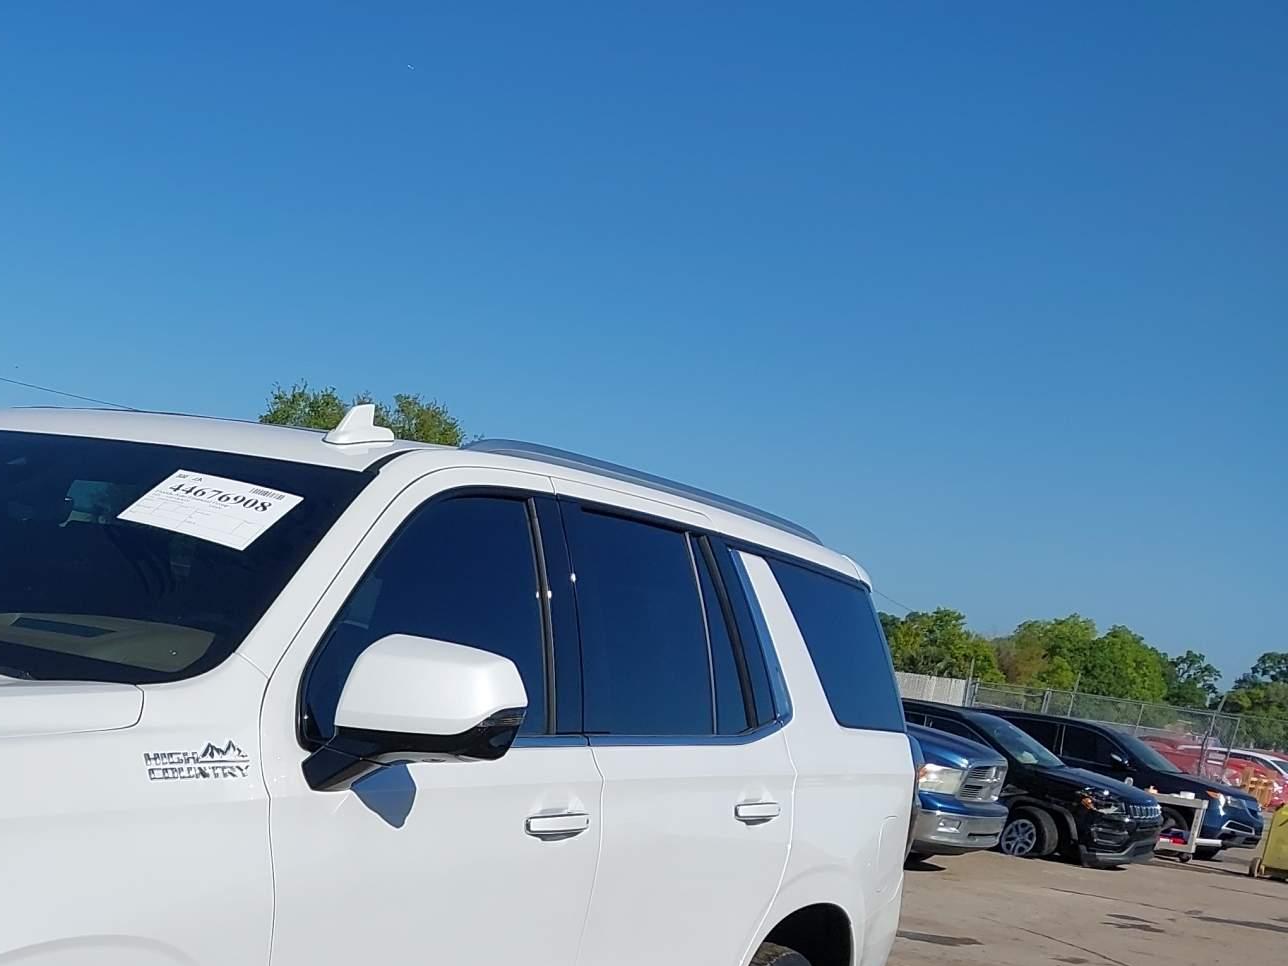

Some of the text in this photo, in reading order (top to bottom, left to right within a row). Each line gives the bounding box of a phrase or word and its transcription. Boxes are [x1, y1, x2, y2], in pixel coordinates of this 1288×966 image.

[169, 482, 273, 513] 44676908
[144, 751, 200, 766] HIGH
[148, 764, 250, 781] COUNTRY
